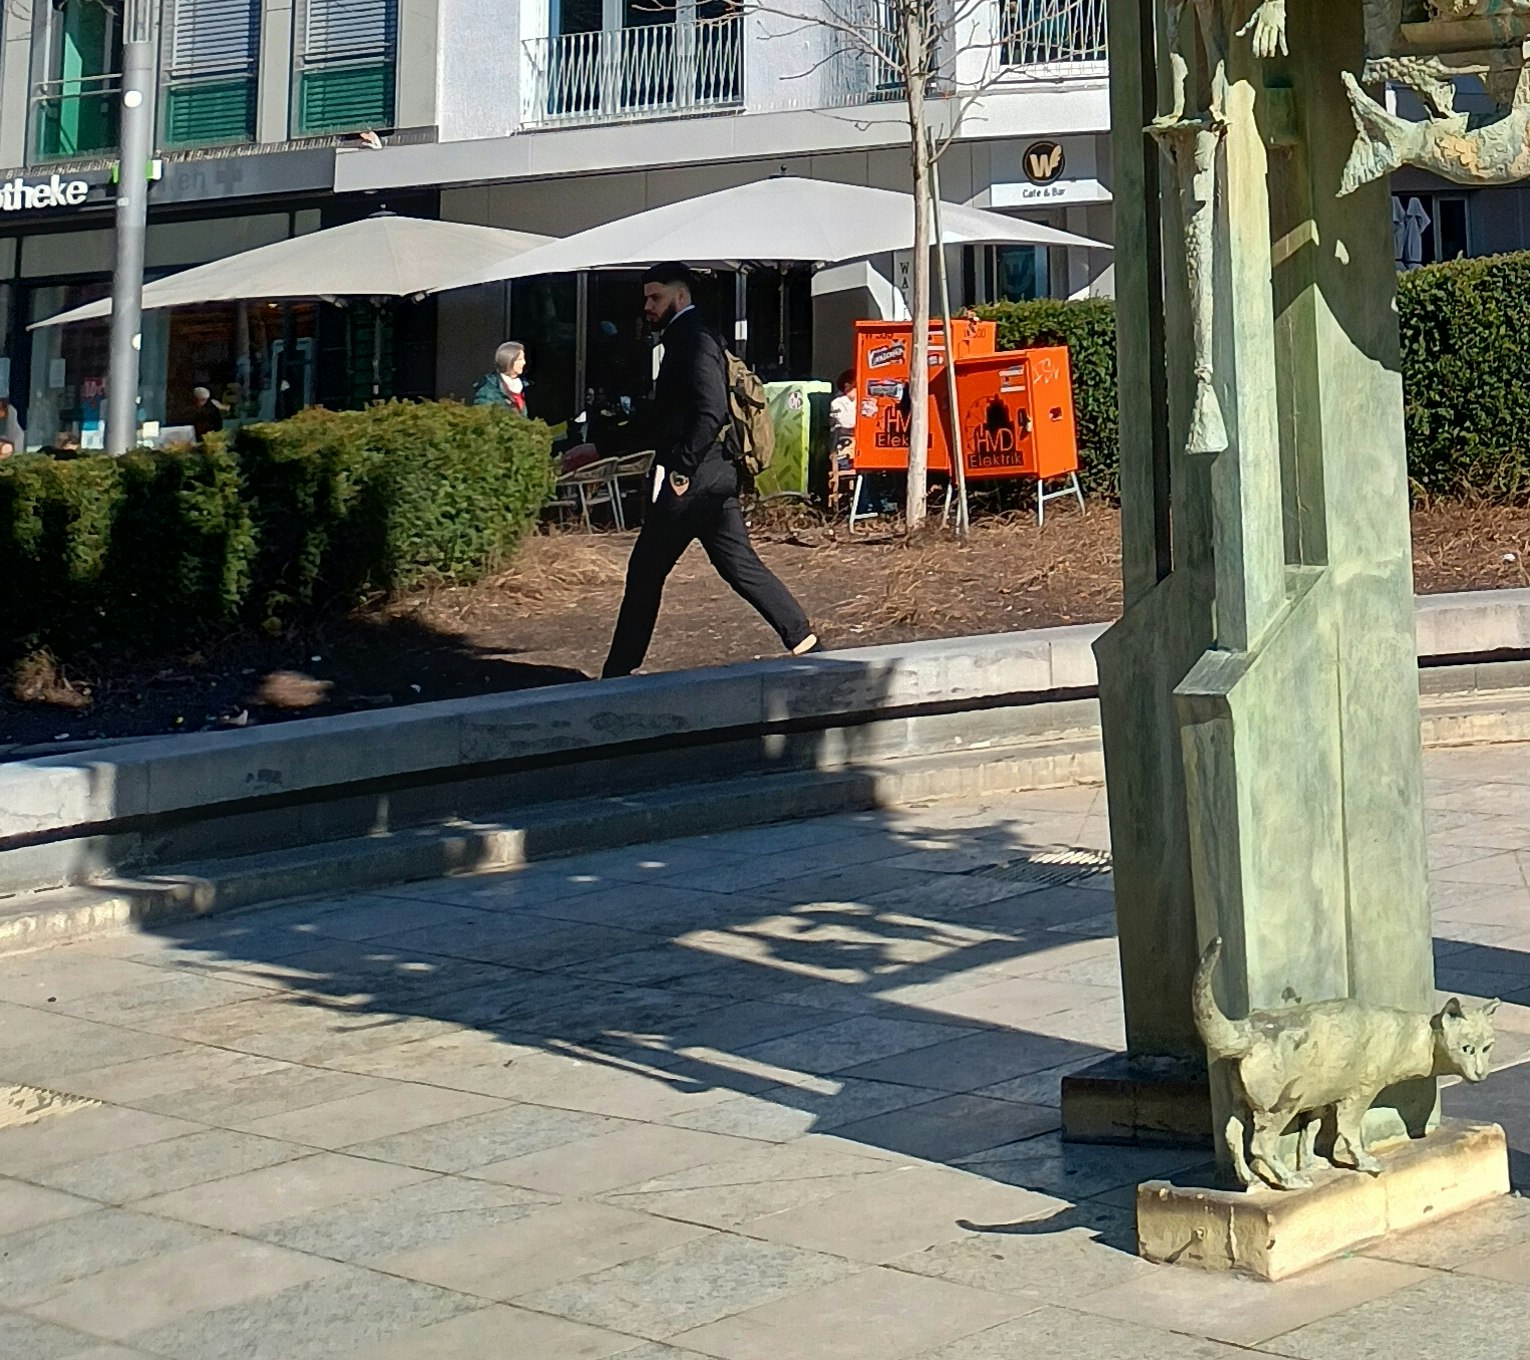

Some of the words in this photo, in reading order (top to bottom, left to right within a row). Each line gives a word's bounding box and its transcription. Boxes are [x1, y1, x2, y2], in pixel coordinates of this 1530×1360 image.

[887, 408, 911, 433] HV
[877, 432, 910, 447] Elek
[976, 427, 1014, 453] HVD
[970, 452, 1022, 468] Elektrik
